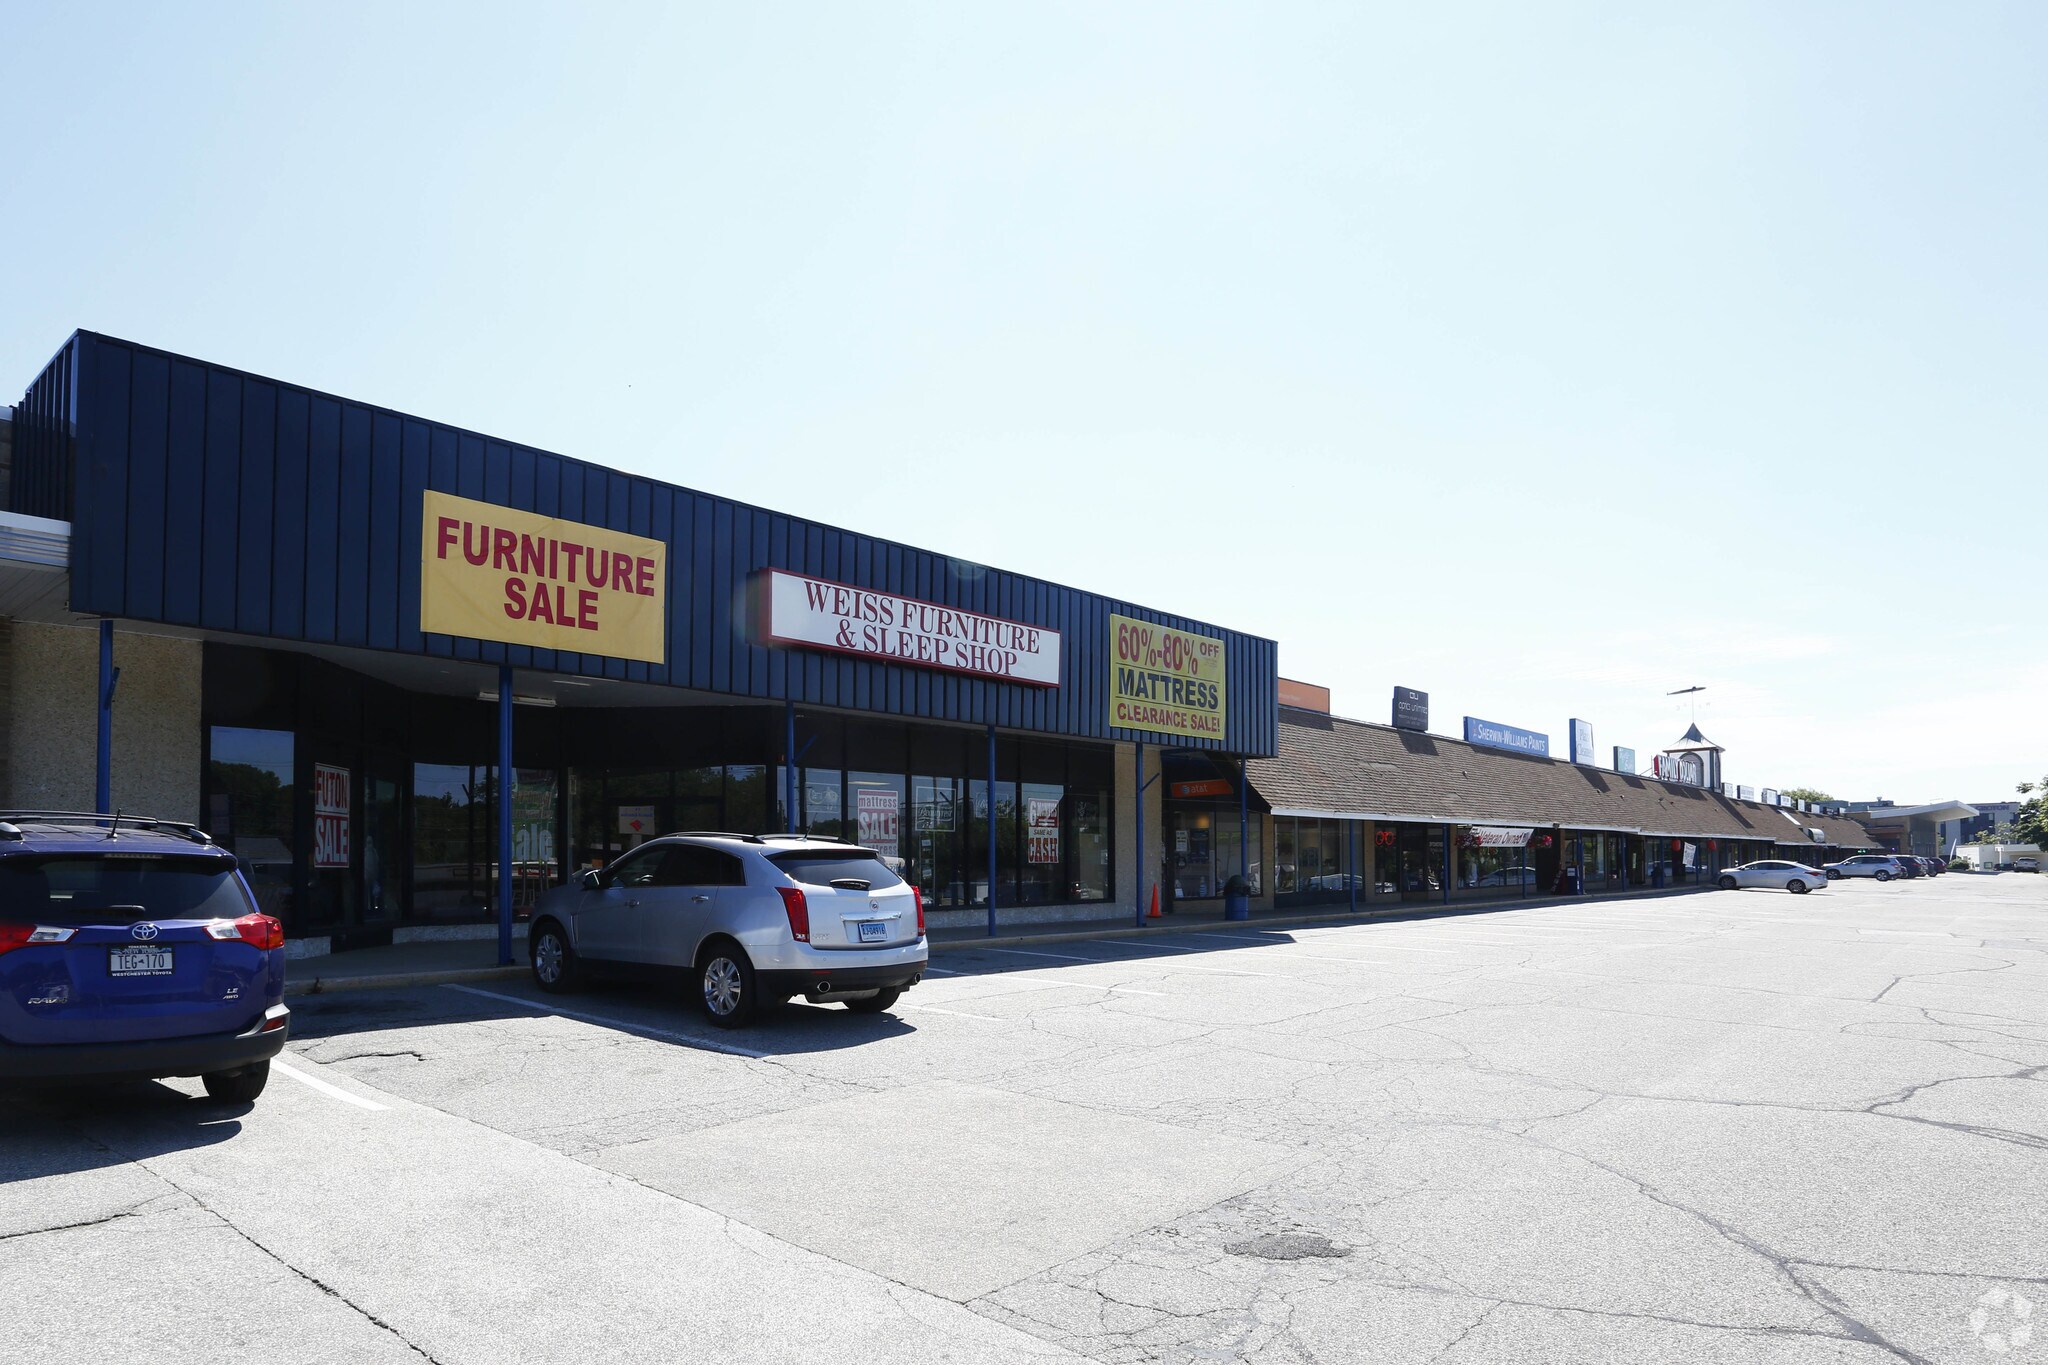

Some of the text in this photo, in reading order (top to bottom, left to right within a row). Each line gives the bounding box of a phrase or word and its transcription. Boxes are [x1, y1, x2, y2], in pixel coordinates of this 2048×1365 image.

[437, 516, 655, 597] FURNITURE
[503, 577, 599, 631] SALE
[803, 580, 1040, 654] WEISS FURNITURE
[835, 619, 1018, 676] & SLEEP SHOP
[1200, 642, 1219, 658] OFF
[1118, 667, 1218, 710] MATTRESS
[1117, 702, 1220, 732] CLEARANCE SALE!
[315, 770, 348, 808] FUTON
[859, 796, 897, 808] mattress
[859, 811, 897, 840] SALE
[1030, 800, 1037, 827] 6
[314, 817, 349, 863] SALE
[1029, 838, 1057, 862] CASH
